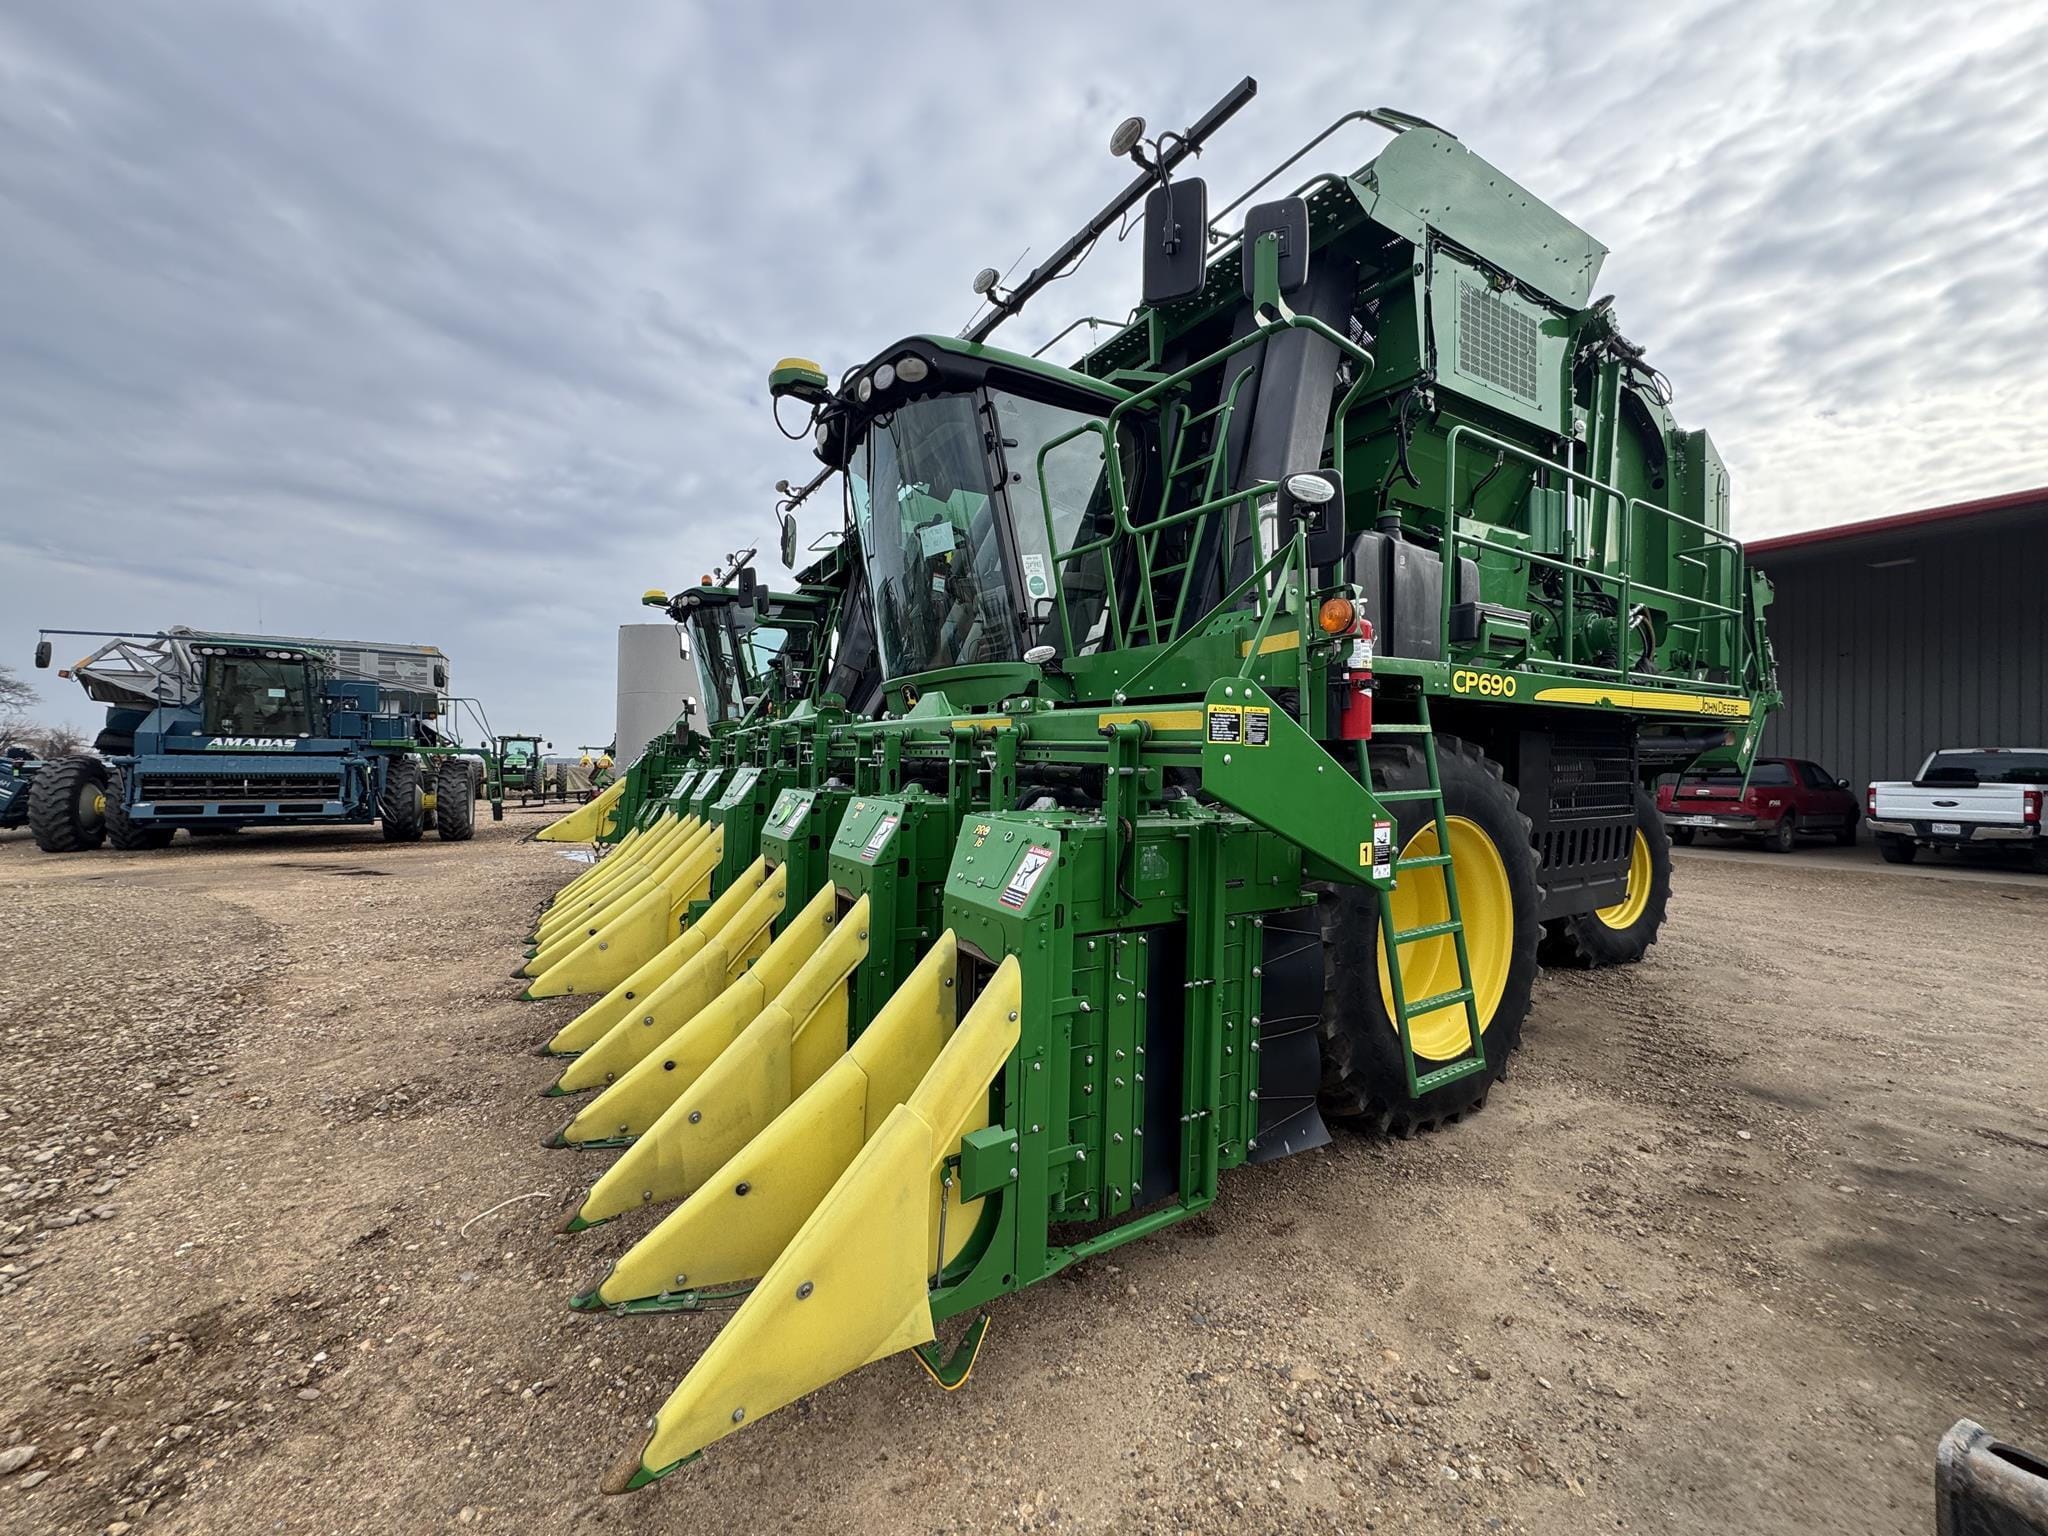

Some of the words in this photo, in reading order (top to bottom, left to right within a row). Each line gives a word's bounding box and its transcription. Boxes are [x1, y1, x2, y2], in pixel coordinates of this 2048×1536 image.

[1452, 670, 1516, 697] CP690
[1718, 700, 1739, 715] DEERE
[207, 737, 297, 747] AMADAS
[973, 824, 991, 836] PRO
[1363, 845, 1369, 863] 1
